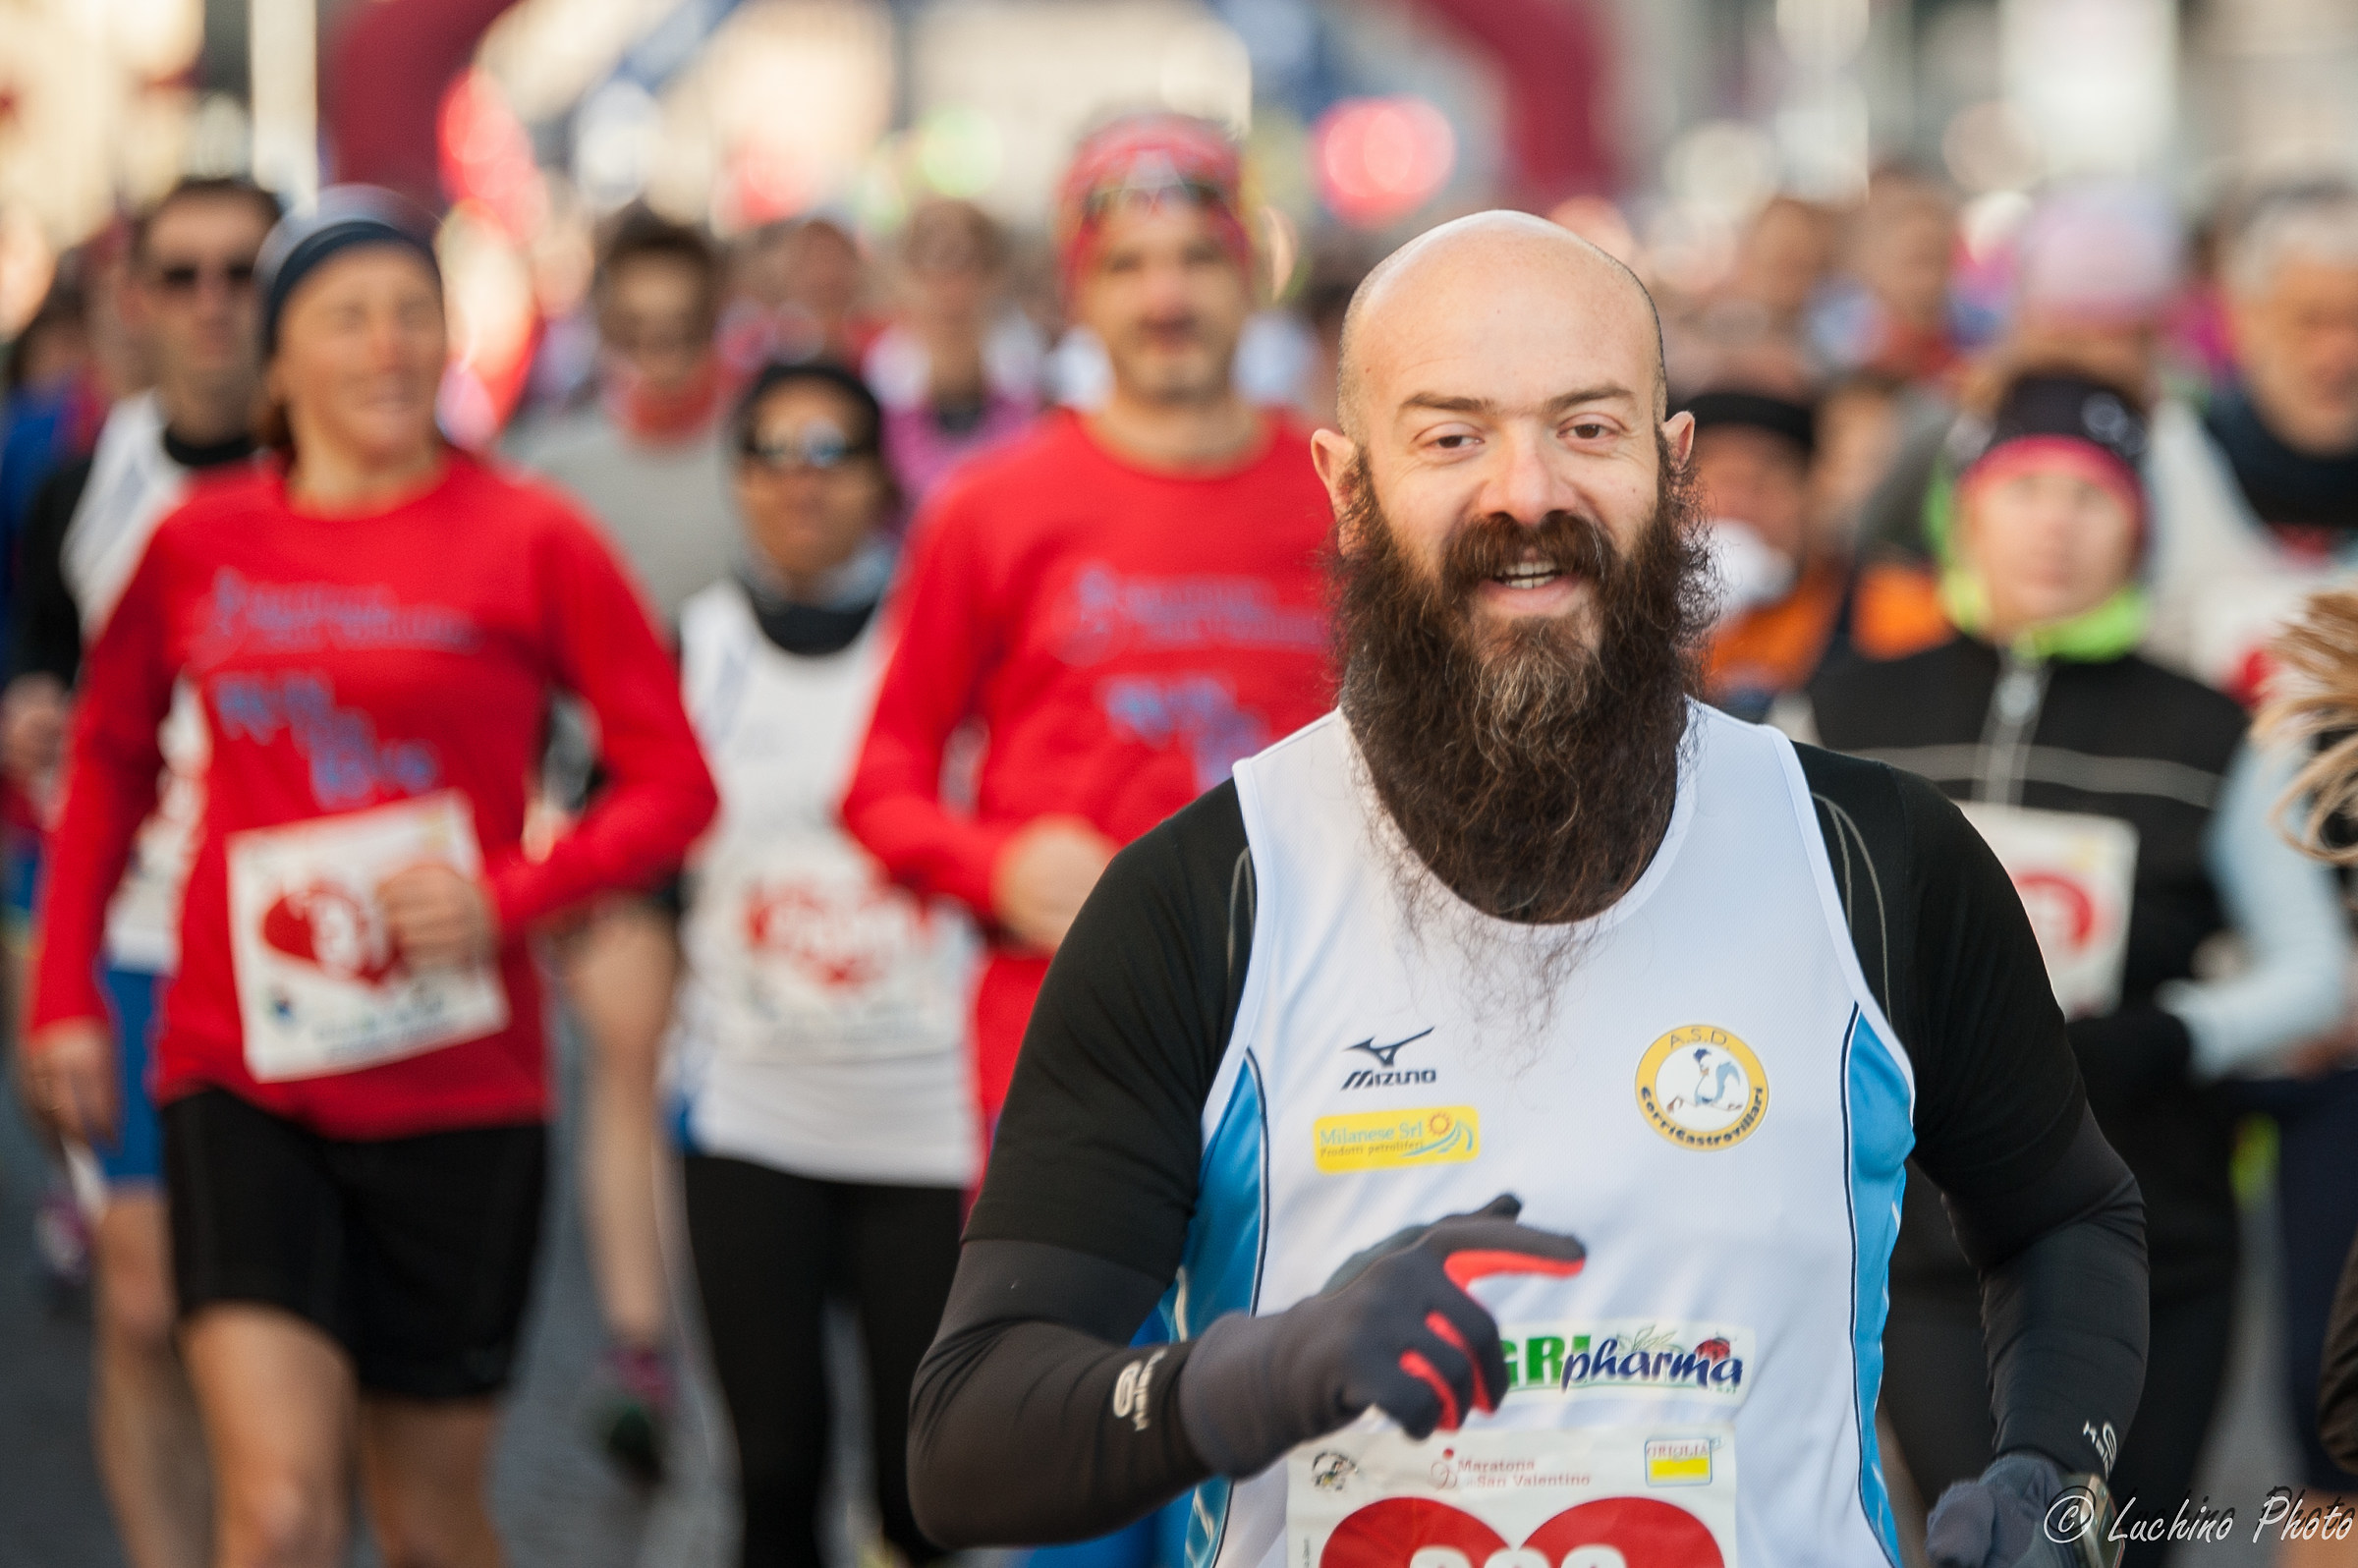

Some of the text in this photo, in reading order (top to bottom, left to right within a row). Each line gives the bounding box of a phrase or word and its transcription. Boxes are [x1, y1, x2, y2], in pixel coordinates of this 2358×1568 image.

[1319, 1120, 1424, 1146] Milanese Srl
[1319, 1140, 1425, 1158] Prodotti petroliferi
[1458, 1459, 1535, 1473] Maratona
[1477, 1476, 1506, 1488] San
[1513, 1473, 1591, 1487] Valentino
